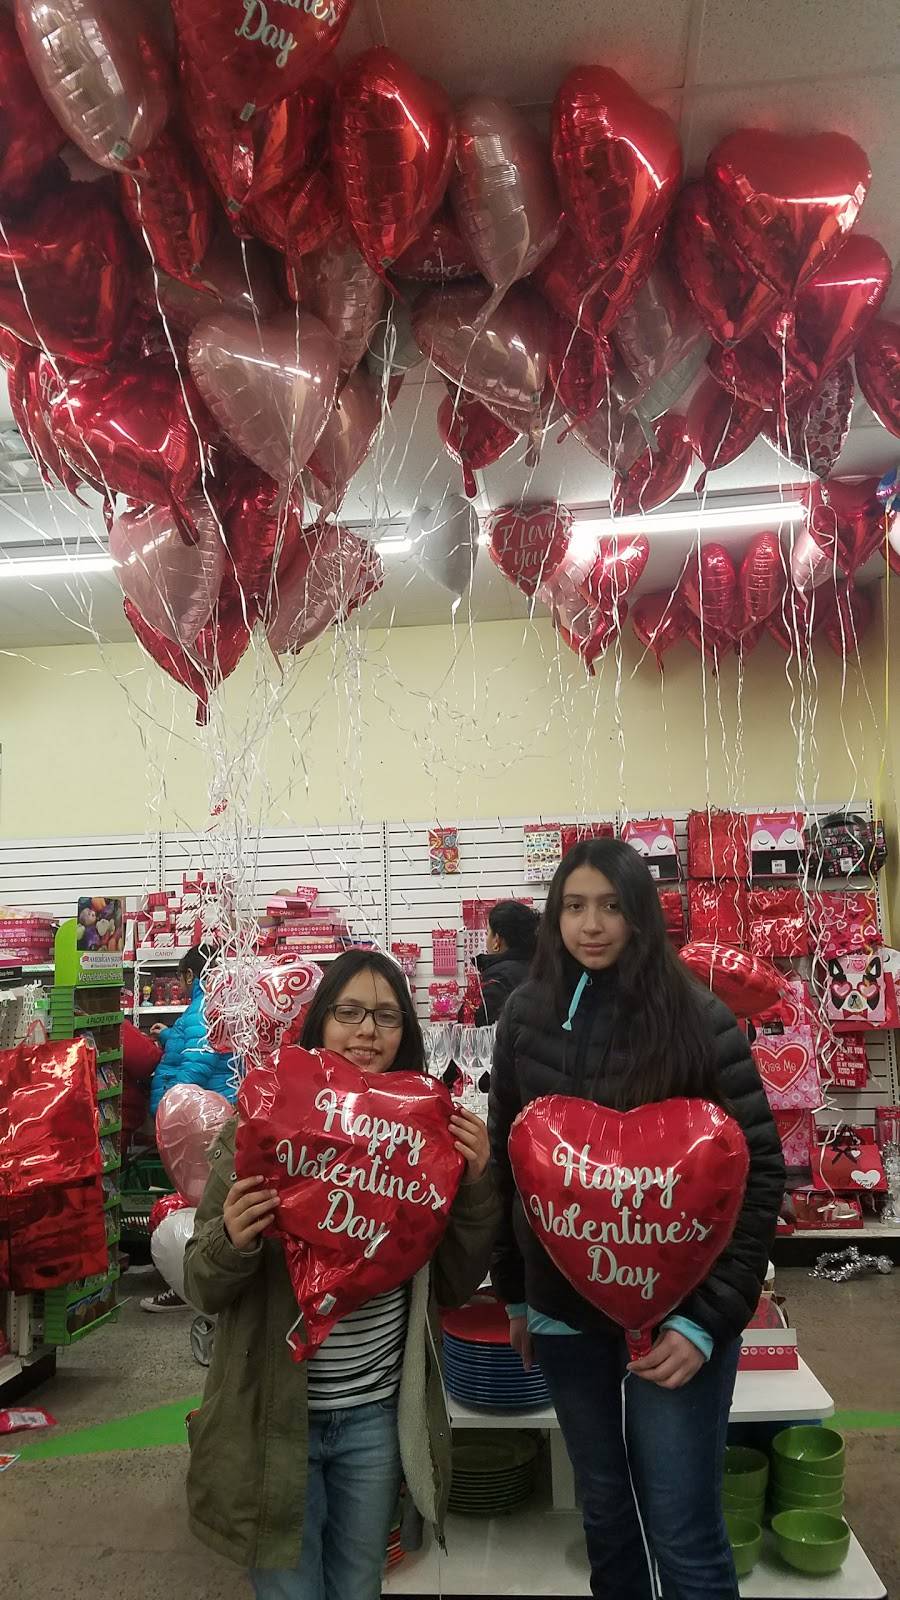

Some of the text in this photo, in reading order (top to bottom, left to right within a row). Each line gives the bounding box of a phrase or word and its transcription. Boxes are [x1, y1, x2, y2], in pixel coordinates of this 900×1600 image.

[235, 0, 298, 68] Day
[499, 525, 513, 553] I
[760, 1057, 797, 1074] Kiss Me
[315, 1088, 426, 1165] Happy
[275, 1139, 447, 1210] Valentine's
[552, 1142, 681, 1209] Happy
[318, 1189, 390, 1259] Day
[530, 1194, 713, 1244] Valentine's
[587, 1244, 660, 1300] Day
